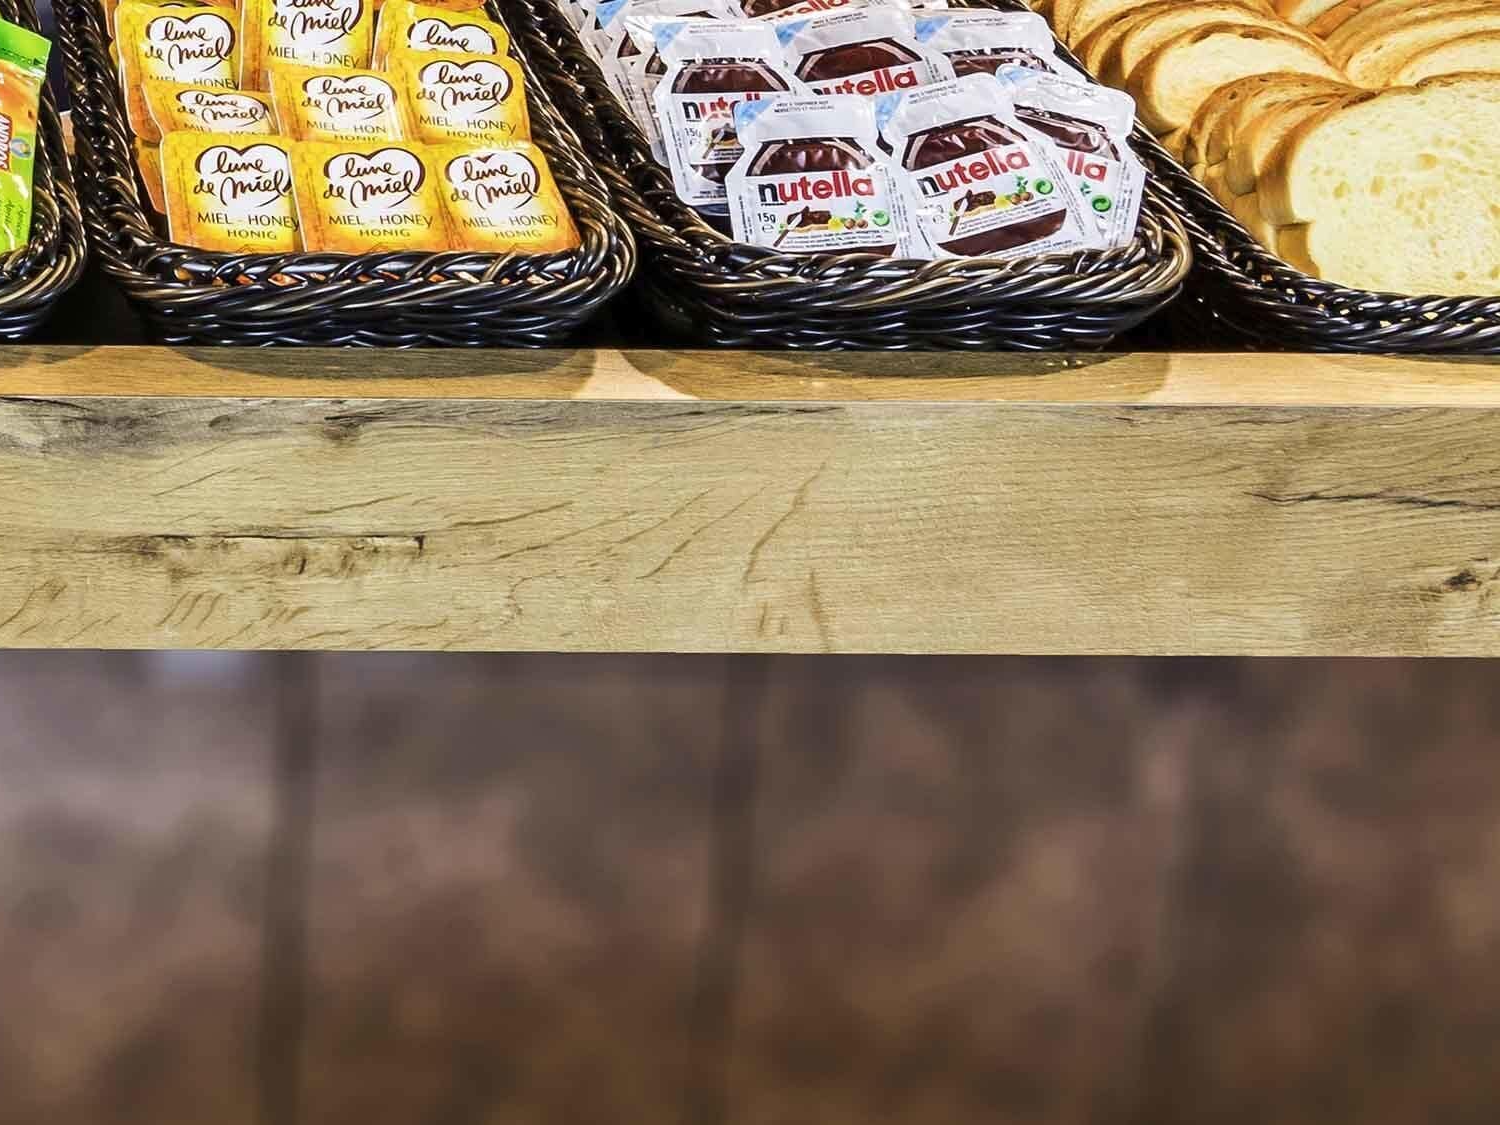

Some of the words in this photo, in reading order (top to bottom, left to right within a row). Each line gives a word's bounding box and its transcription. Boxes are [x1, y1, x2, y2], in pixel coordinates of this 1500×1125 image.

[162, 21, 212, 41] lune
[268, 13, 286, 30] de
[291, 4, 355, 44] miel
[420, 24, 471, 51] lune
[145, 43, 163, 59] de
[168, 37, 228, 71] miel
[267, 46, 298, 59] MIEL
[433, 64, 491, 86] lune
[318, 79, 371, 95] lune
[416, 86, 436, 100] de
[441, 82, 508, 113] miel
[301, 96, 321, 108] de
[326, 93, 387, 118] miel
[419, 114, 452, 127] MIEL
[211, 151, 270, 174] lune
[340, 157, 399, 178] lune
[464, 160, 518, 182] lune
[917, 150, 1031, 197] nutella
[193, 180, 215, 195] de
[220, 169, 292, 206] miel
[323, 184, 344, 199] de
[350, 169, 419, 208] miel
[450, 187, 470, 202] de
[475, 173, 541, 209] miel
[758, 171, 875, 204] nutella
[197, 212, 230, 225] MIEL
[328, 215, 364, 226] MIEL
[463, 217, 496, 228] MIEL
[227, 230, 277, 240] HONIG
[359, 228, 411, 238] HONIG
